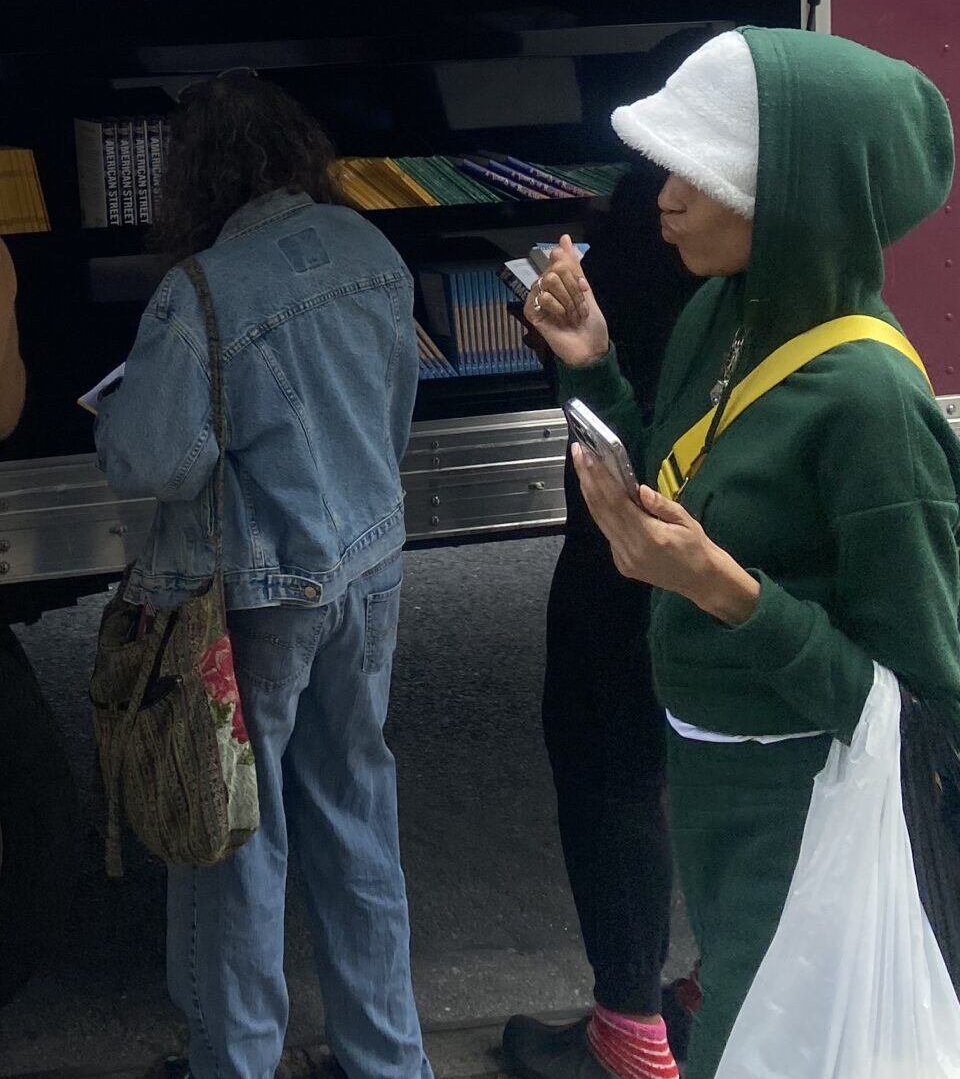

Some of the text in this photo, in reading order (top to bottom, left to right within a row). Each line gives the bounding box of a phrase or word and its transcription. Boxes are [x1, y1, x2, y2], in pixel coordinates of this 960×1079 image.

[105, 140, 120, 226] AMERICAN STREET
[120, 140, 134, 225] AMERICAN STREET
[135, 139, 149, 223] AMERICAN STREET
